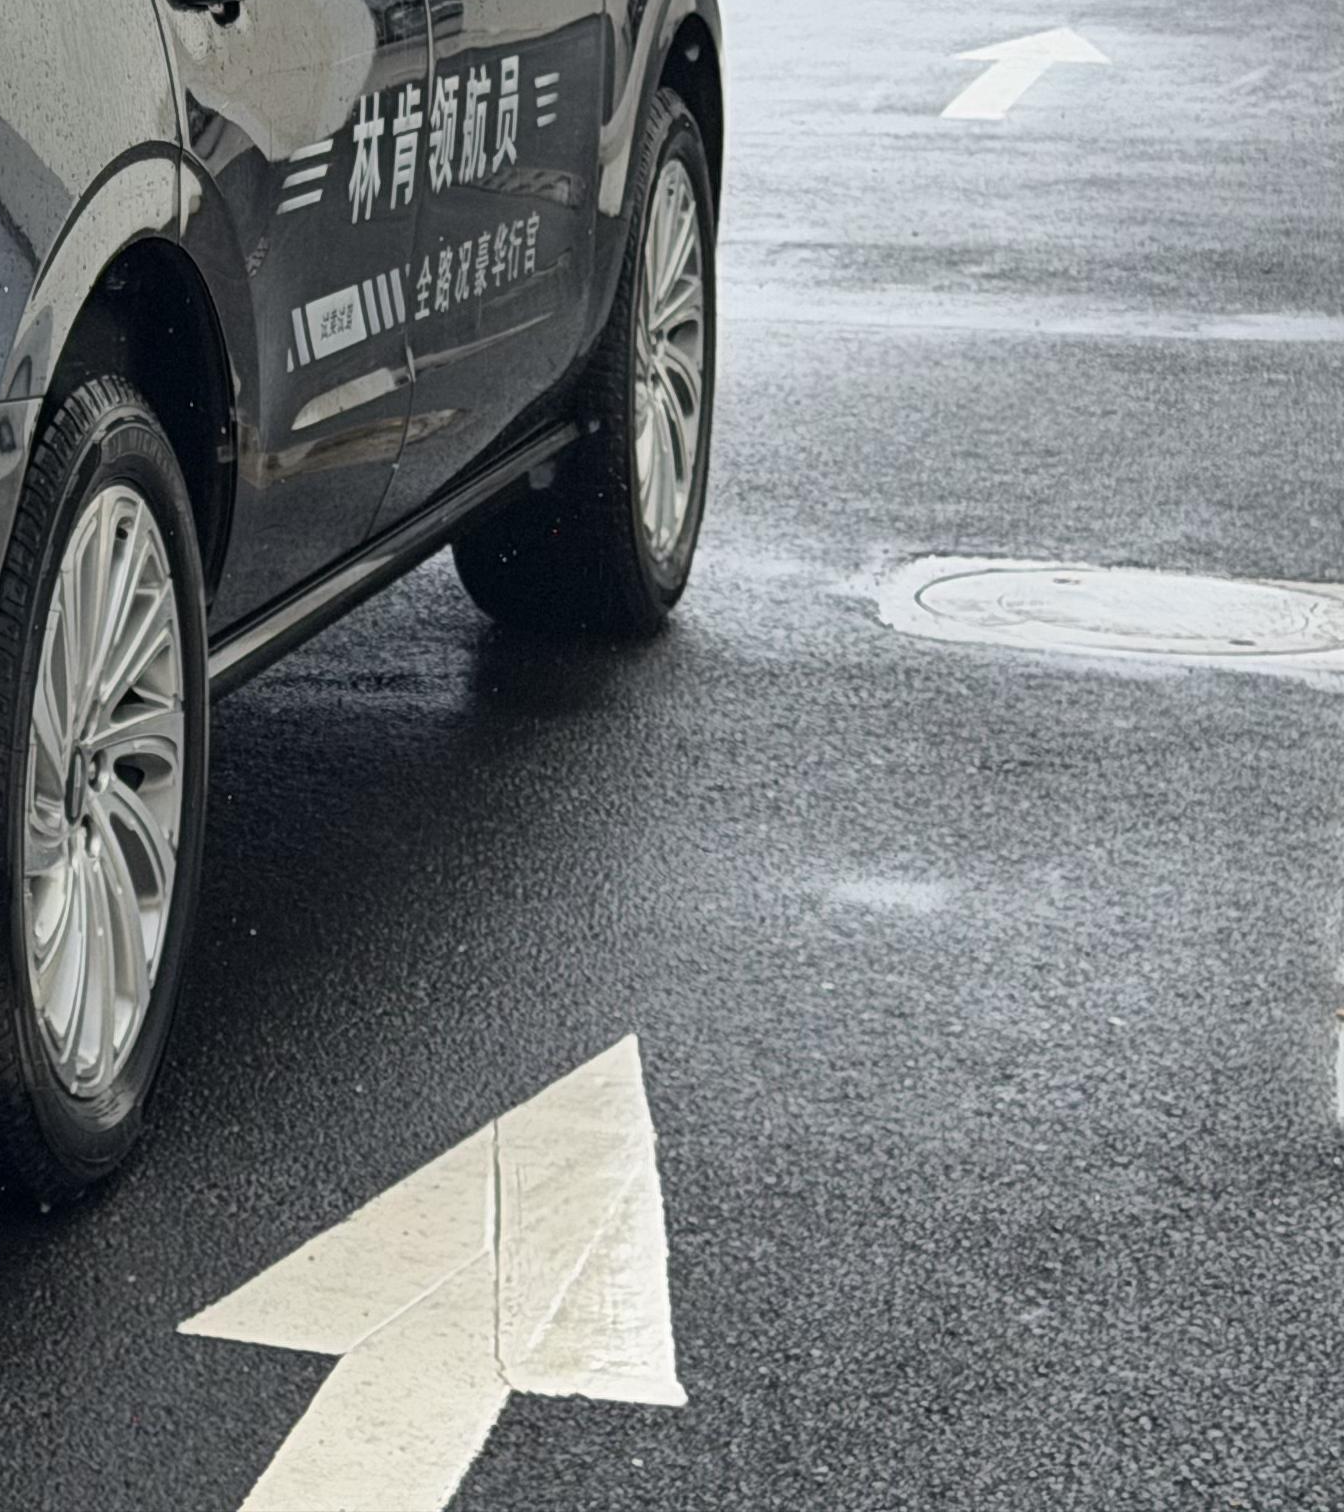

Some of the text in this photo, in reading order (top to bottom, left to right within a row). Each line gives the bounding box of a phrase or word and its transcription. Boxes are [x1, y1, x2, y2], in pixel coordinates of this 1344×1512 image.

[348, 54, 519, 224] 林肯领航员
[414, 210, 540, 320] 全路况豪华行宫
